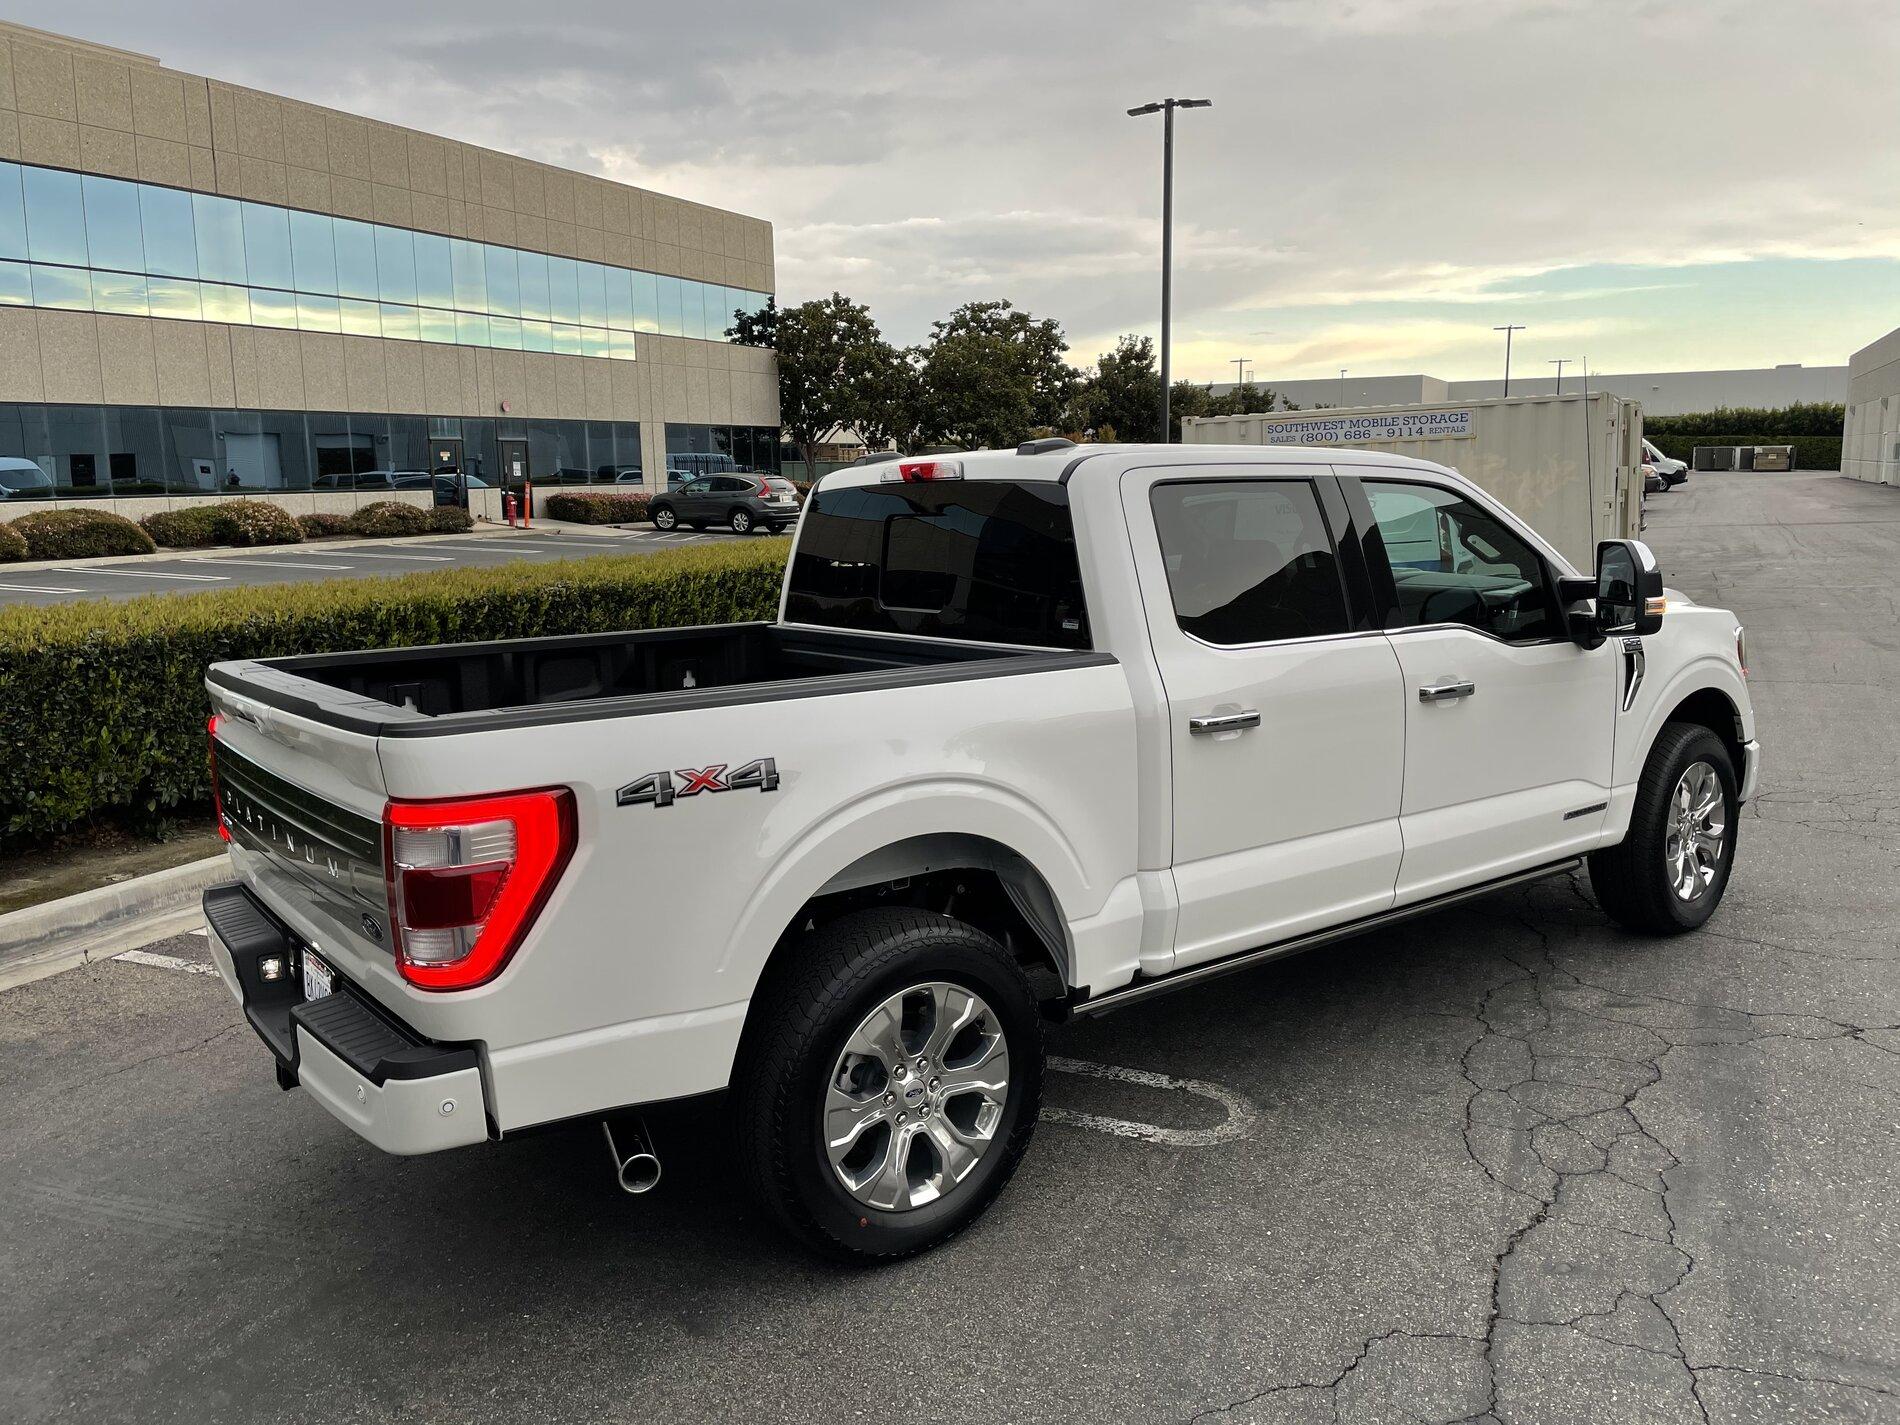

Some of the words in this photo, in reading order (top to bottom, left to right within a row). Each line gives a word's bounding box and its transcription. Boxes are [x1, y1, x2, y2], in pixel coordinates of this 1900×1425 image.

[1267, 420, 1346, 434] SOUTHWEST
[1349, 417, 1399, 429] MOBILE
[1402, 413, 1469, 426] STORAGE
[1270, 435, 1296, 443] SALES
[1300, 431, 1339, 444] (800)
[1344, 429, 1371, 440] 686
[1387, 426, 1424, 438] 9114
[1429, 426, 1466, 434] RENTALS
[227, 790, 339, 878] PLATINUM
